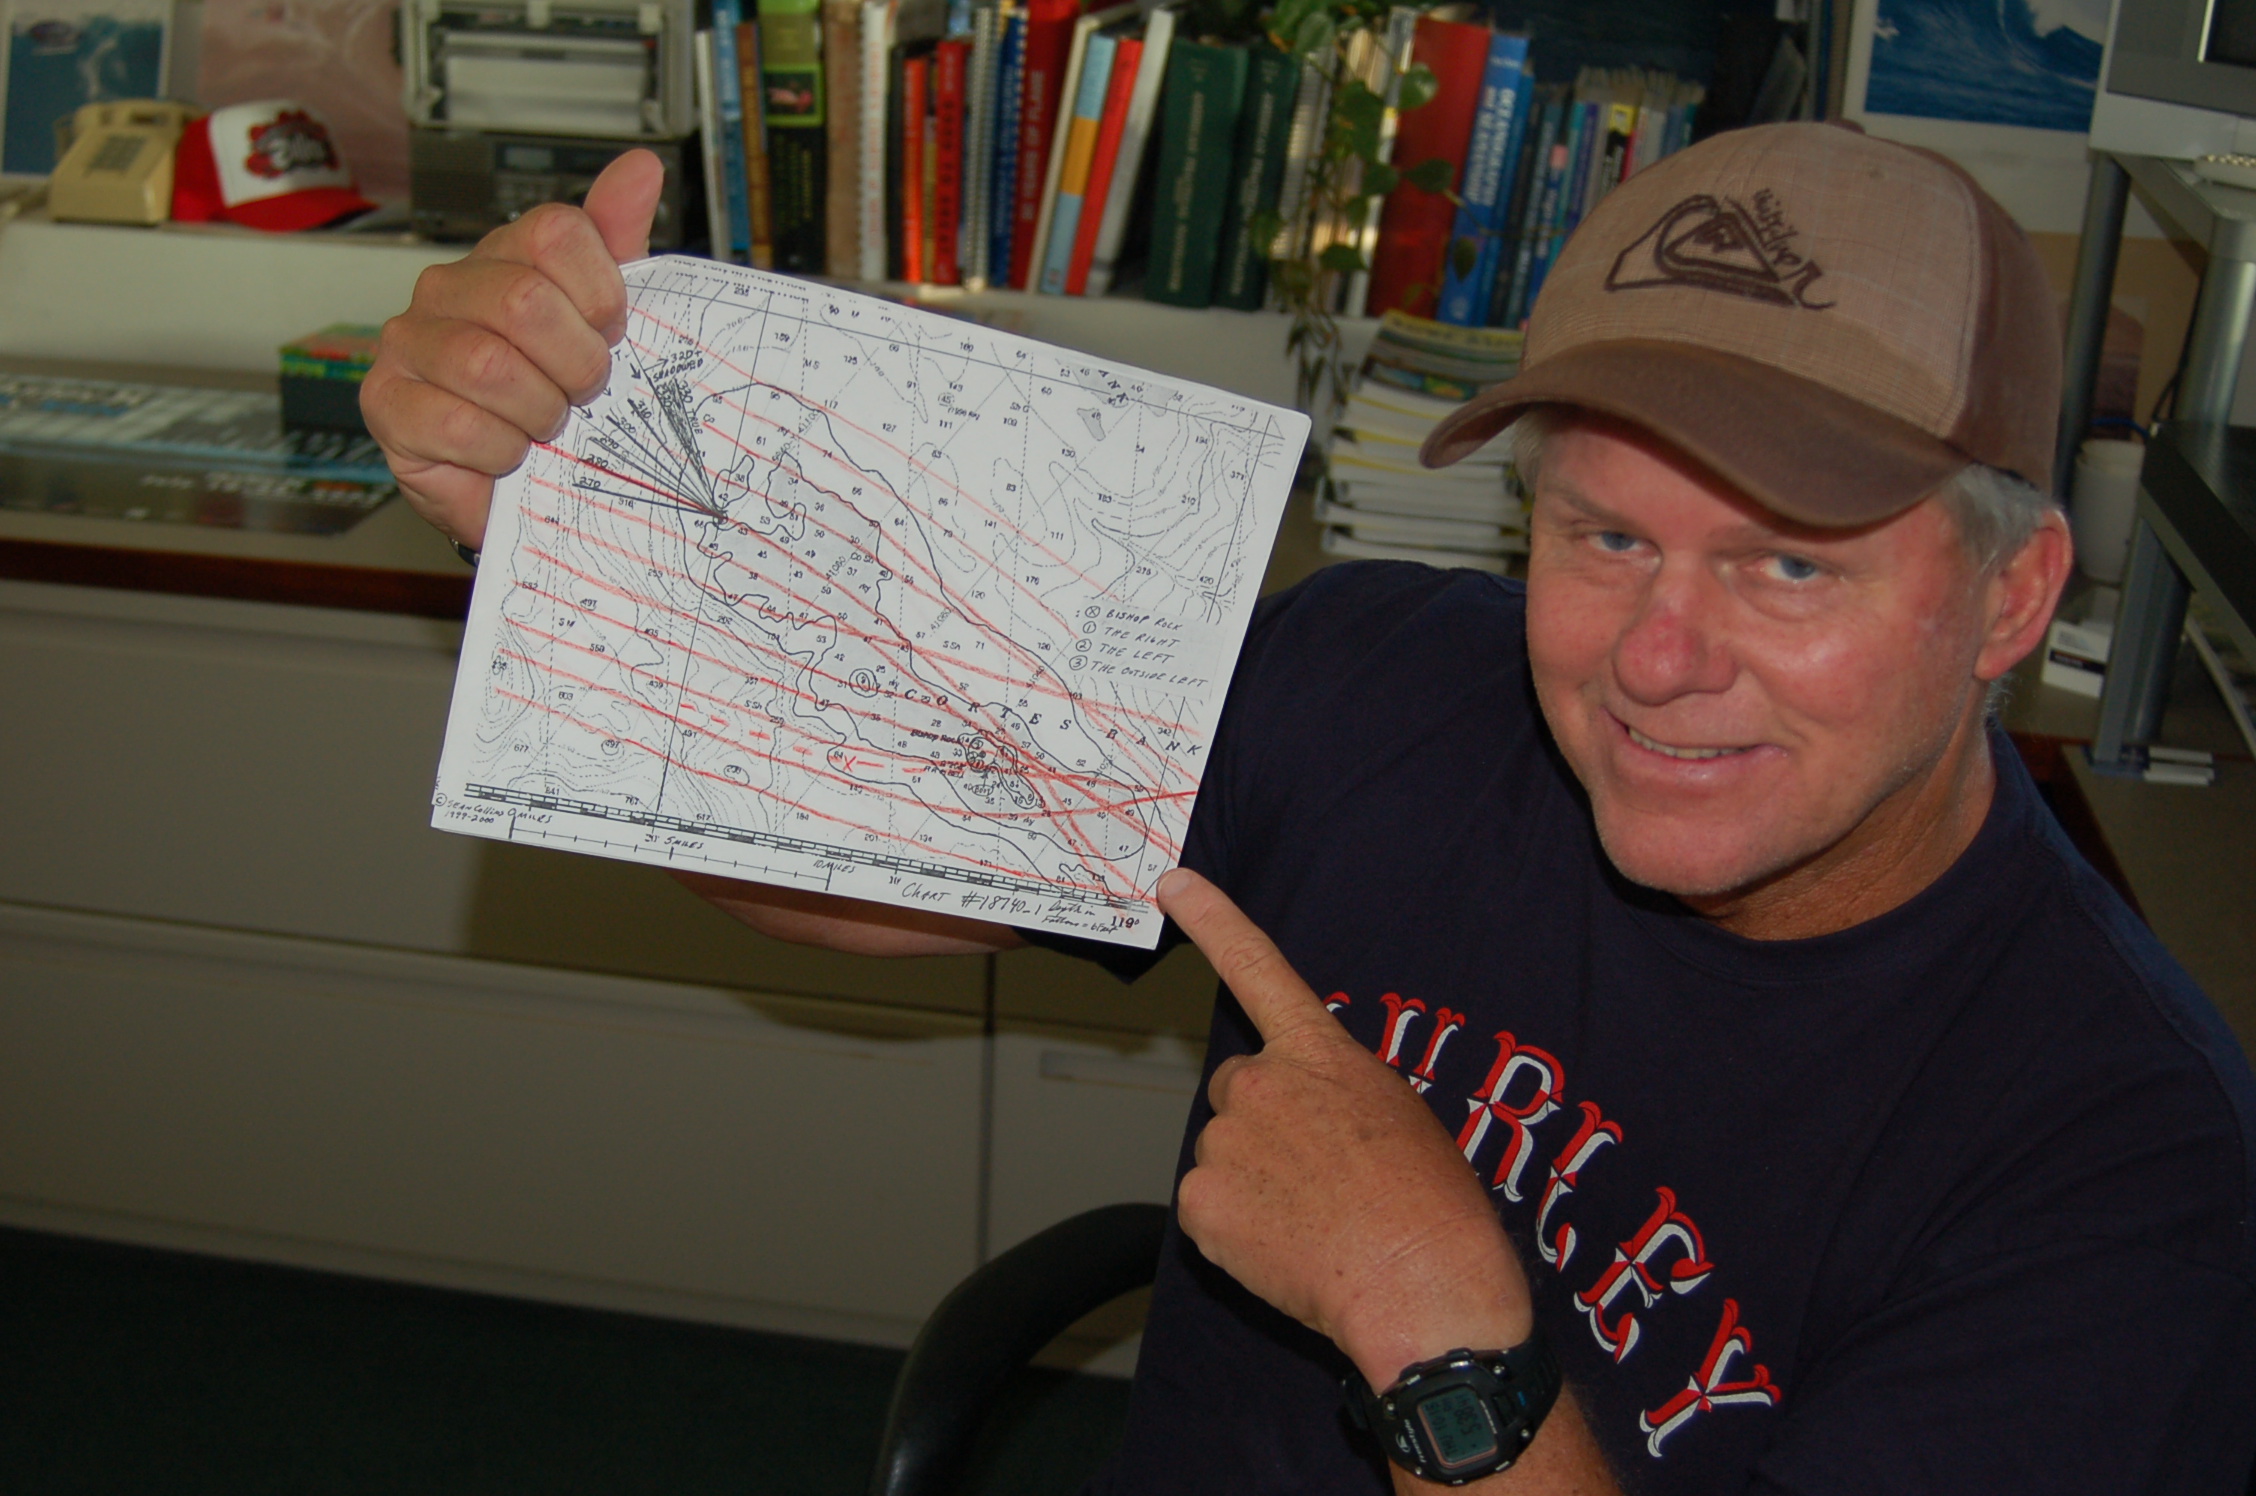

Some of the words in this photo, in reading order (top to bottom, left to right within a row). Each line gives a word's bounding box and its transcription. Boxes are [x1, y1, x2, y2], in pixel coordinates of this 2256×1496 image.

[1106, 609, 1150, 624] BISHOP
[1154, 618, 1183, 630] ROCK
[1104, 627, 1128, 639] THE
[1135, 633, 1181, 648] RIGHT
[1099, 643, 1124, 657] THE
[1133, 651, 1175, 664] LEFT
[1091, 661, 1117, 675] THE
[1121, 666, 1167, 681] OUTSIDE
[1169, 675, 1208, 688] LEFT
[1324, 991, 1782, 1458] URLEY
